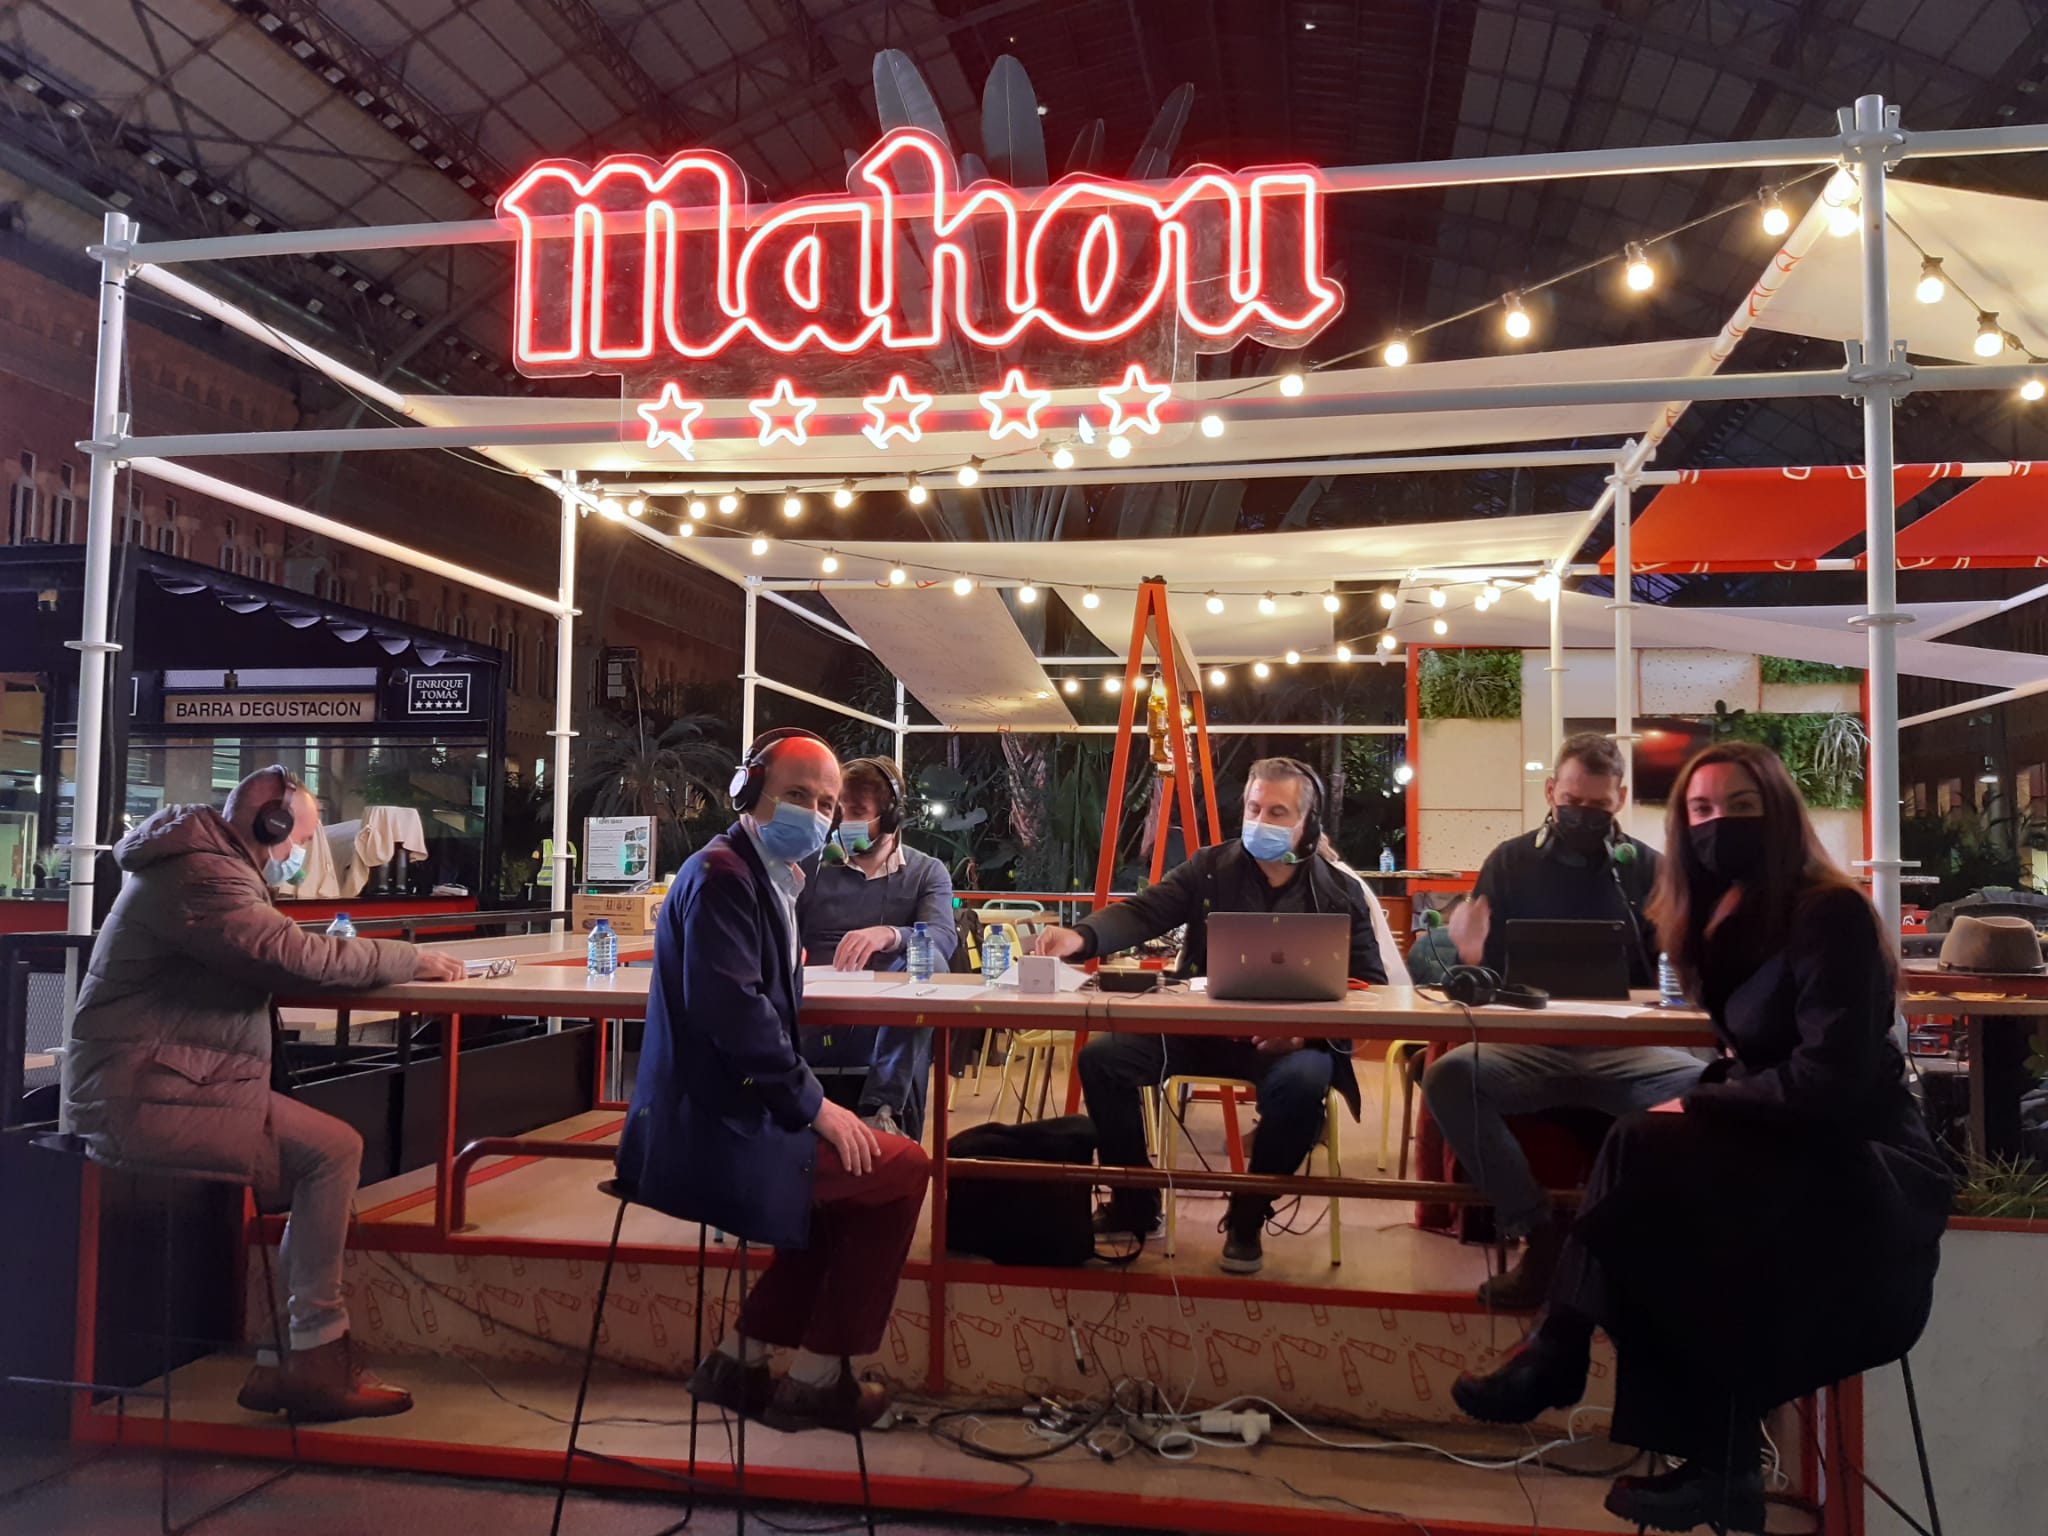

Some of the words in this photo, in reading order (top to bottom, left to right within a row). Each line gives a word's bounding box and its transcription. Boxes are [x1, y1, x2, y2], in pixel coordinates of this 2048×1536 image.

[500, 133, 1343, 363] Mahou
[416, 679, 464, 690] ENRIQUE
[176, 702, 234, 717] BARRA
[239, 699, 361, 716] DEGUSTACIÓN
